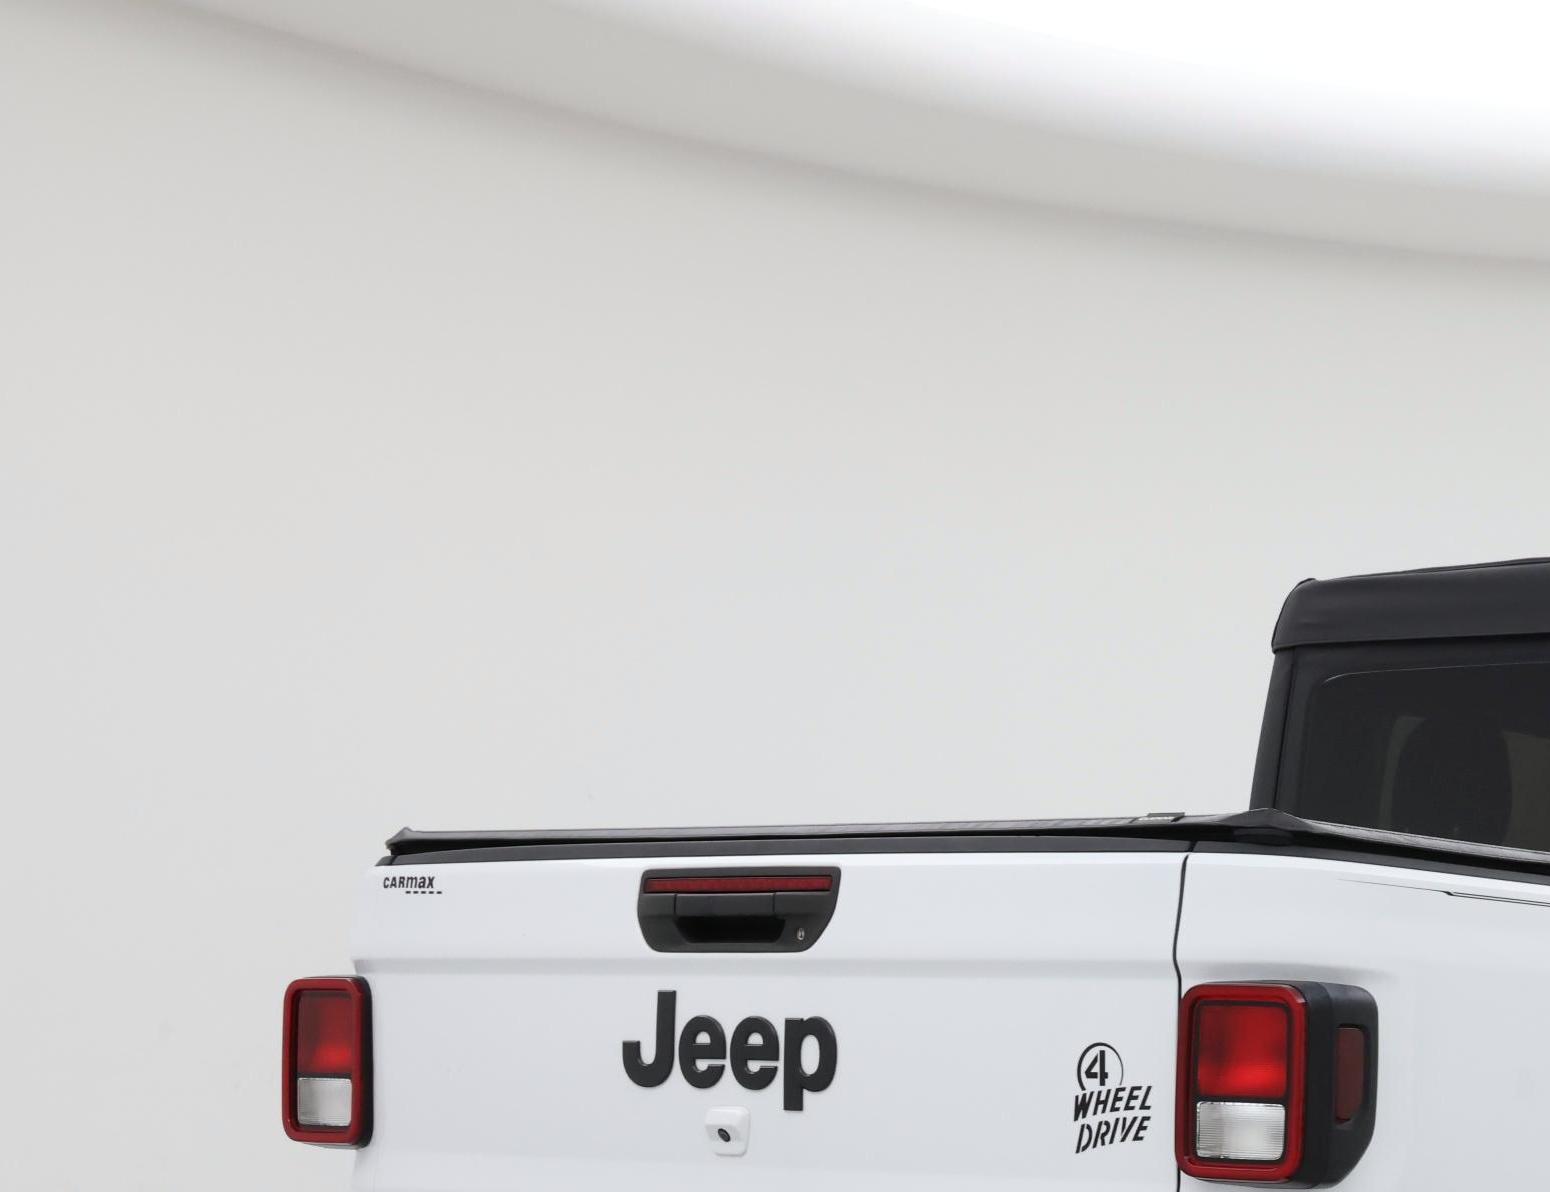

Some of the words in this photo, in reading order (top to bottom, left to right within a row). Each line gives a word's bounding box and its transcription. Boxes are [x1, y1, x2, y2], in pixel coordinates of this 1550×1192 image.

[622, 989, 838, 1111] Jeep
[1084, 1049, 1109, 1087] 4
[1073, 1085, 1153, 1122] WHEEL
[1075, 1116, 1152, 1154] DRIVE
